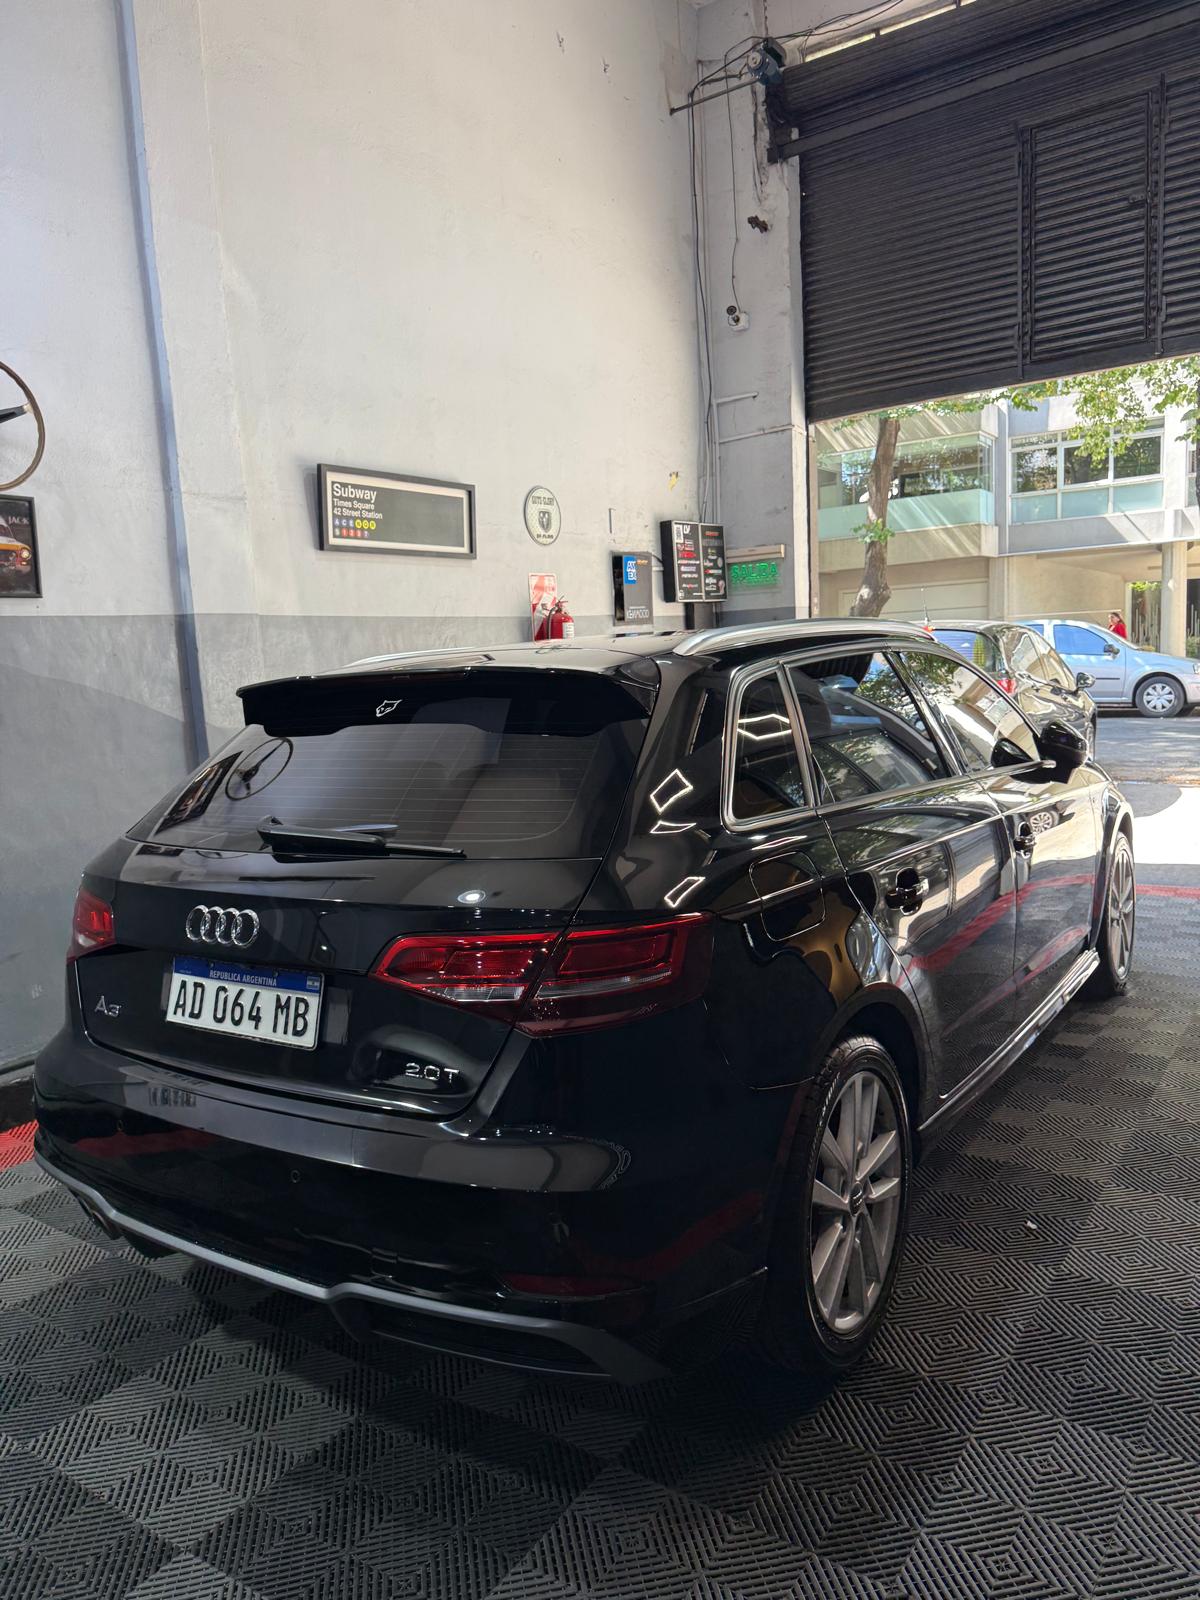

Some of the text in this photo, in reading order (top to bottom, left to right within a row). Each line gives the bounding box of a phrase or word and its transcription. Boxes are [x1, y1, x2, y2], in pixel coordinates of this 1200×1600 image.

[333, 483, 377, 503] Subway
[333, 498, 375, 510] Times Square
[333, 507, 383, 519] 42 Street Station
[209, 969, 277, 987] REPUBLICA ARGENTINA
[94, 995, 121, 1017] A3
[173, 979, 310, 1037] AD 064 MB
